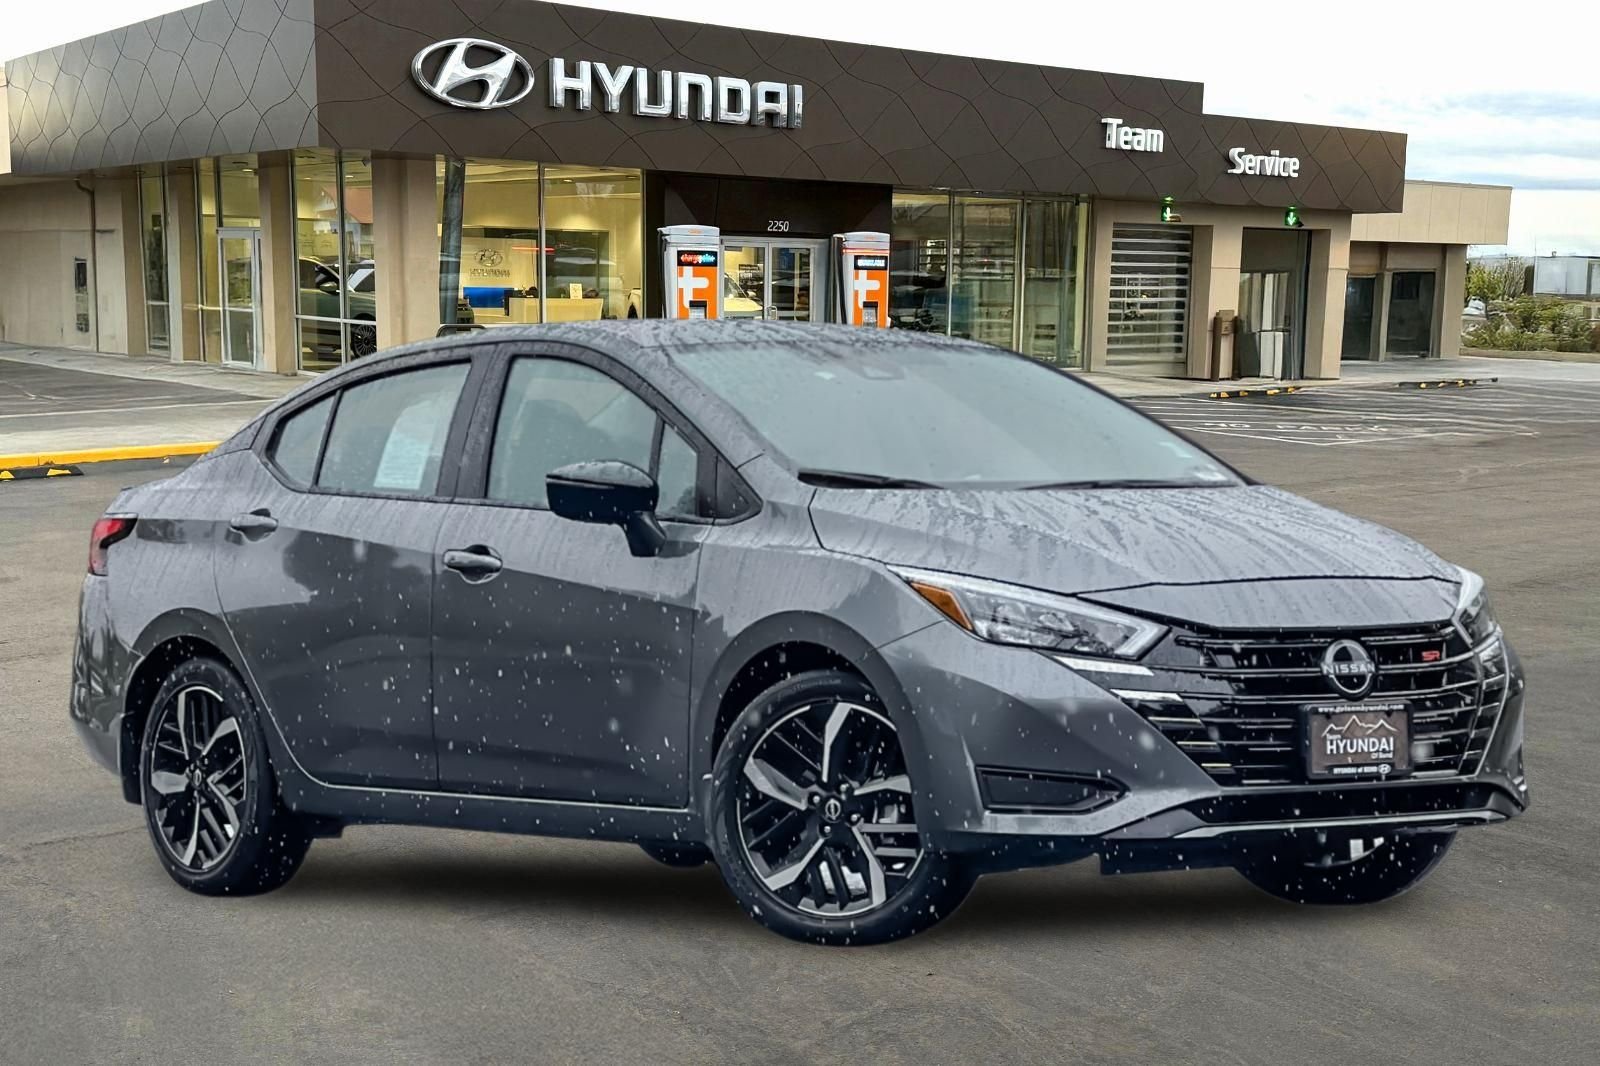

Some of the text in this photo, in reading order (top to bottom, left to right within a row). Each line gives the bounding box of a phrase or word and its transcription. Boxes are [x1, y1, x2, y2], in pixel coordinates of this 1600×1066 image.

[549, 57, 803, 129] HYUNDAI
[1101, 117, 1164, 152] Team
[1227, 147, 1300, 178] Service
[767, 220, 790, 232] 2250
[1422, 651, 1440, 661] SR
[1321, 663, 1376, 675] NISSAN
[1326, 737, 1394, 754] HYUNDAI
